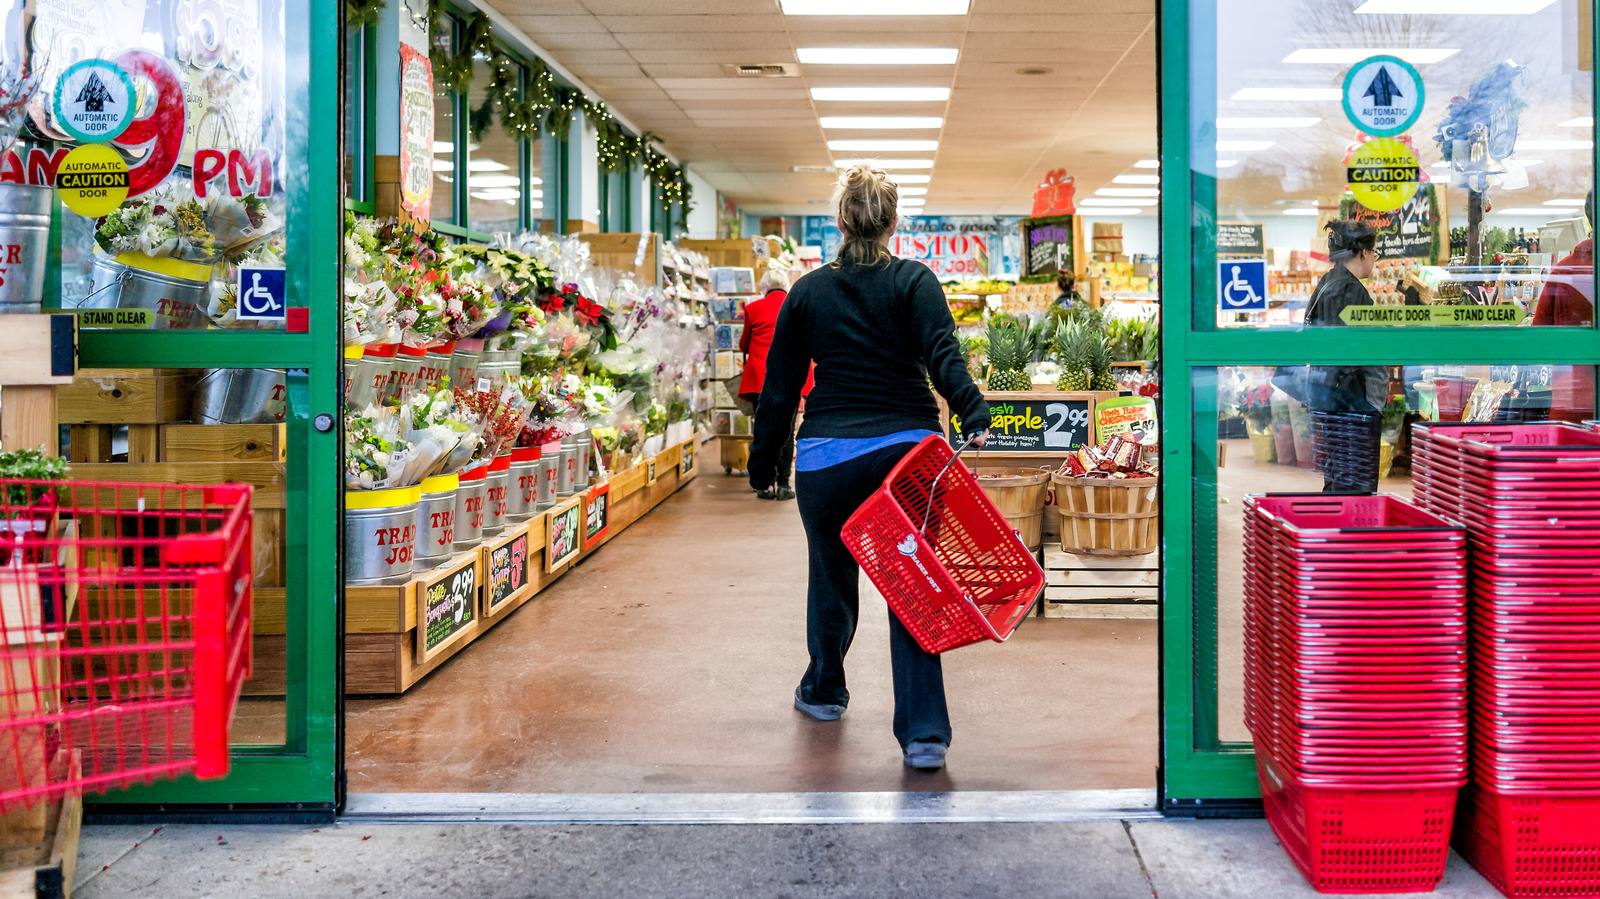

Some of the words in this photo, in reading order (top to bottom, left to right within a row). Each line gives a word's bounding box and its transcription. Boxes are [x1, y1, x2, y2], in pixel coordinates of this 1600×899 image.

[1362, 108, 1408, 117] AUTOMATIC
[73, 113, 118, 122] AUTOMATIC
[1373, 117, 1396, 126] DOOR
[85, 122, 107, 131] DOOR
[1356, 157, 1412, 165] AUTOMATIC
[65, 162, 122, 171] AUTOMATIC
[192, 148, 273, 199] PM
[1352, 168, 1416, 181] CAUTION
[61, 173, 125, 188] CAUTION
[1370, 184, 1399, 192] DOOR
[79, 189, 108, 198] DOOR
[940, 222, 955, 232] to
[83, 312, 113, 324] STAND
[116, 311, 146, 324] CLEAR
[1350, 309, 1403, 321] AUTOMATIC
[1405, 309, 1431, 321] DOOR
[1453, 308, 1484, 321] STAND
[1486, 308, 1516, 321] CLEAR
[1013, 434, 1040, 442] pineapple
